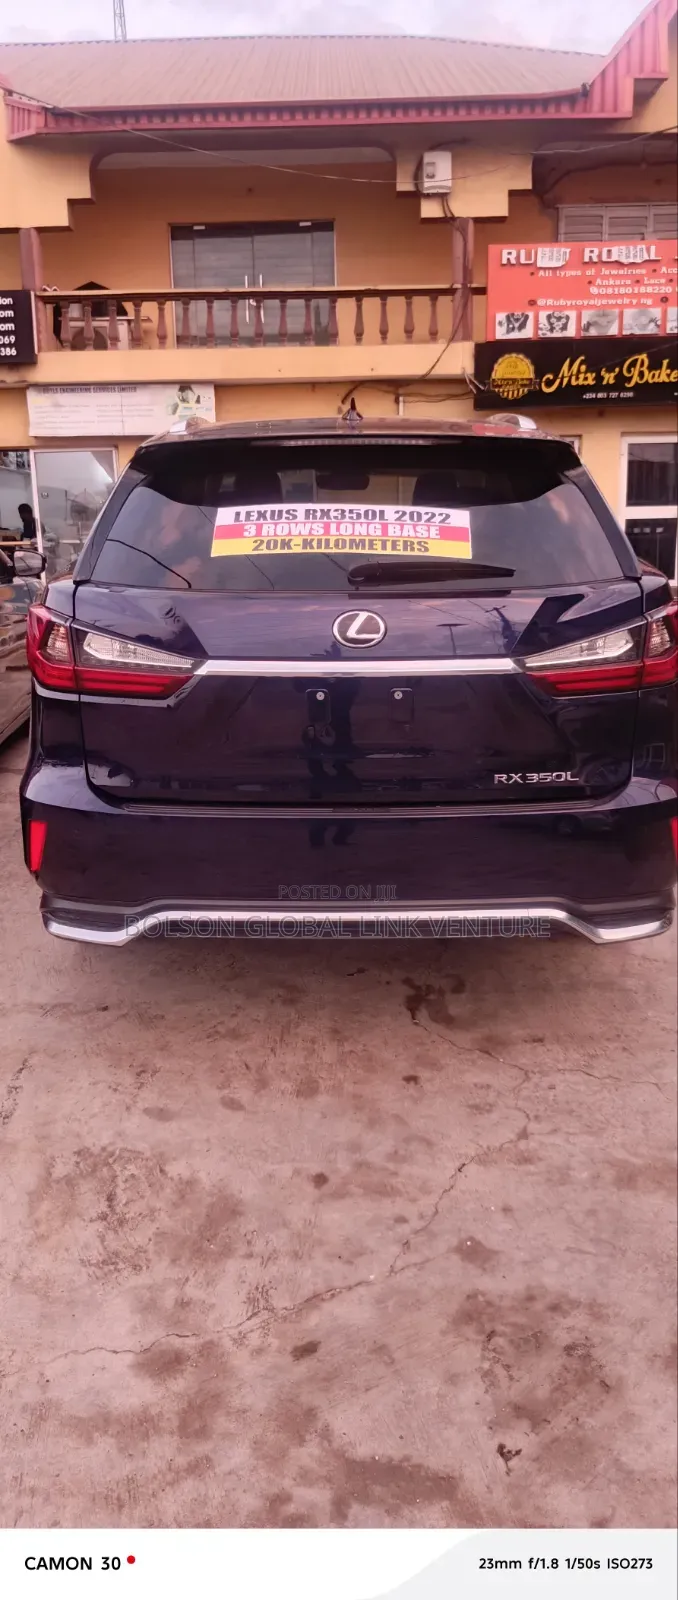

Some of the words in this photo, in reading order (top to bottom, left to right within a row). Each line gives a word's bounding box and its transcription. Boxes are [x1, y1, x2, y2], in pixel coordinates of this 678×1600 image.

[538, 269, 552, 277] All
[556, 268, 582, 278] types
[586, 268, 595, 276] of
[595, 277, 632, 286] Ankara
[643, 276, 667, 284] Lace
[541, 356, 596, 393] Mix
[623, 352, 678, 388] Bake
[234, 508, 299, 524] LEXUS
[304, 508, 389, 521] RX350L
[394, 509, 452, 525] 2022
[243, 524, 257, 538] 3
[261, 523, 323, 537] ROWS
[330, 522, 382, 537] LONG
[388, 523, 441, 539] BASE
[252, 538, 430, 553] 20K-KILOMETERS
